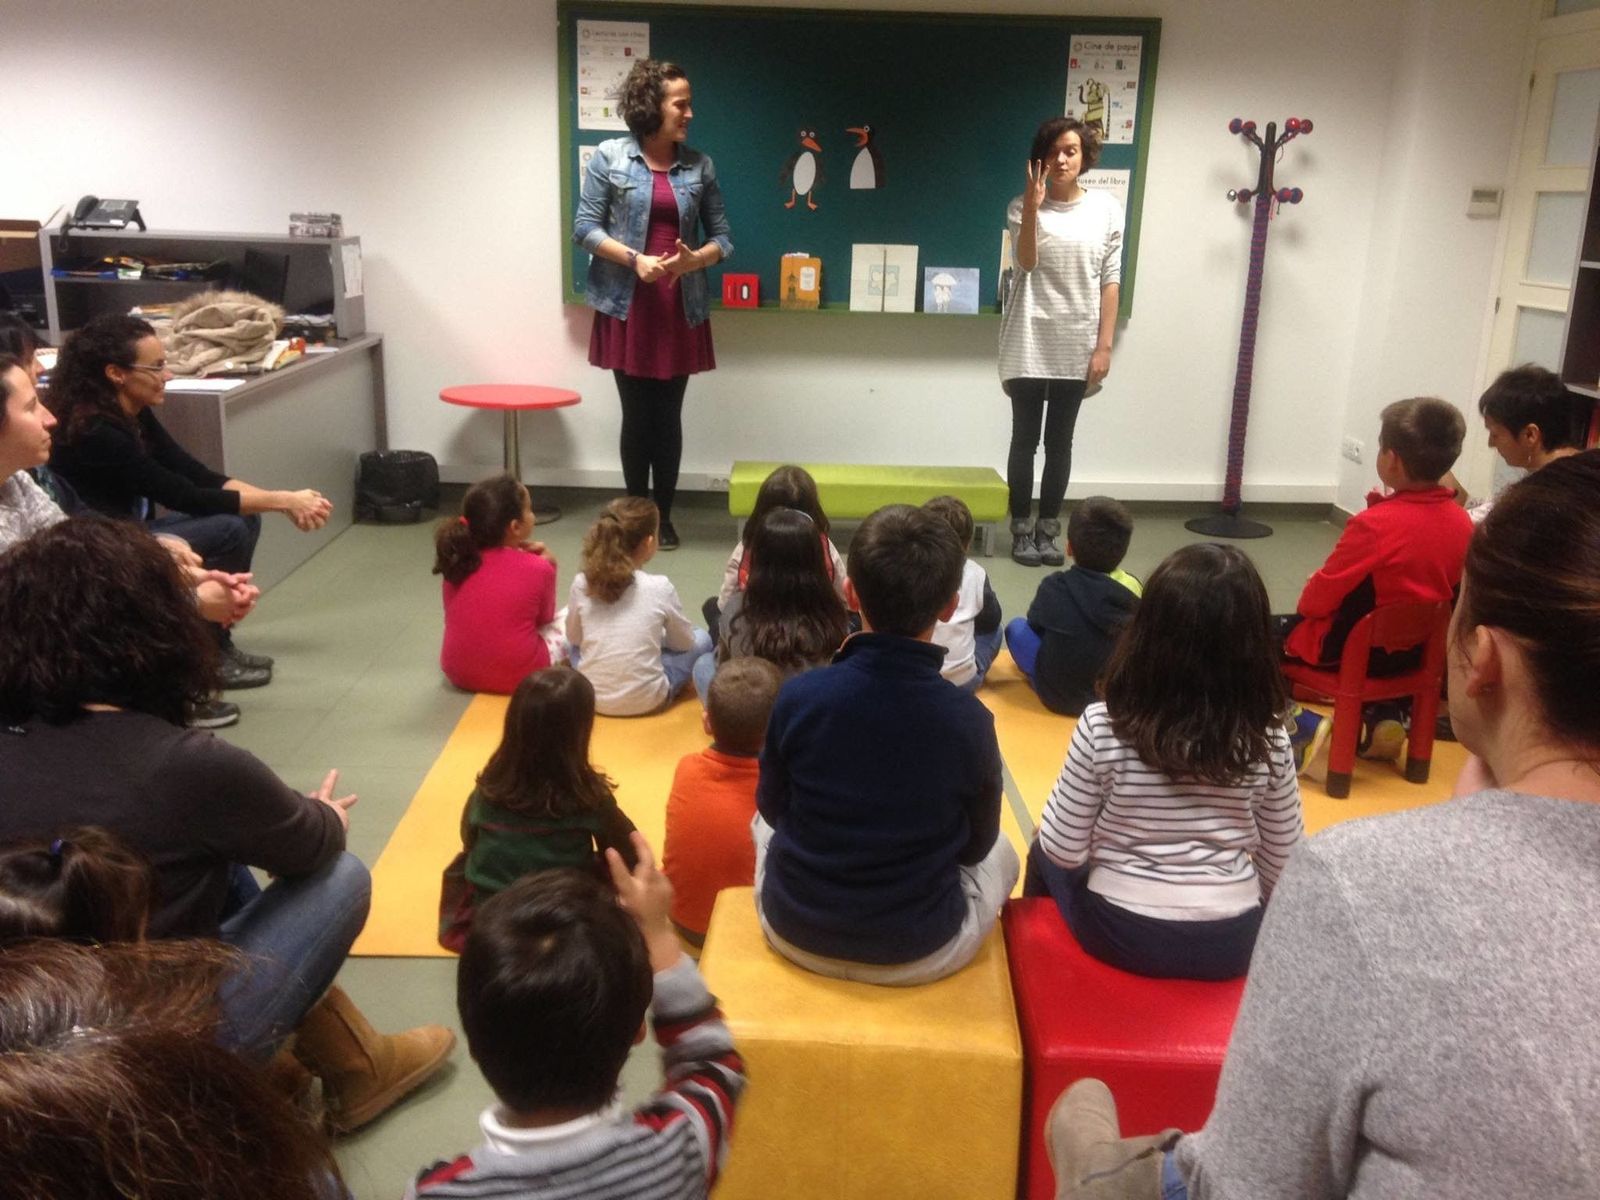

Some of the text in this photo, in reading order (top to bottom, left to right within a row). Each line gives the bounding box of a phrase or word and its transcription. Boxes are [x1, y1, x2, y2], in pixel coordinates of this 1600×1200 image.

[1084, 40, 1140, 53] Cine de papel
[1098, 177, 1109, 185] del
[1111, 177, 1126, 185] libro
